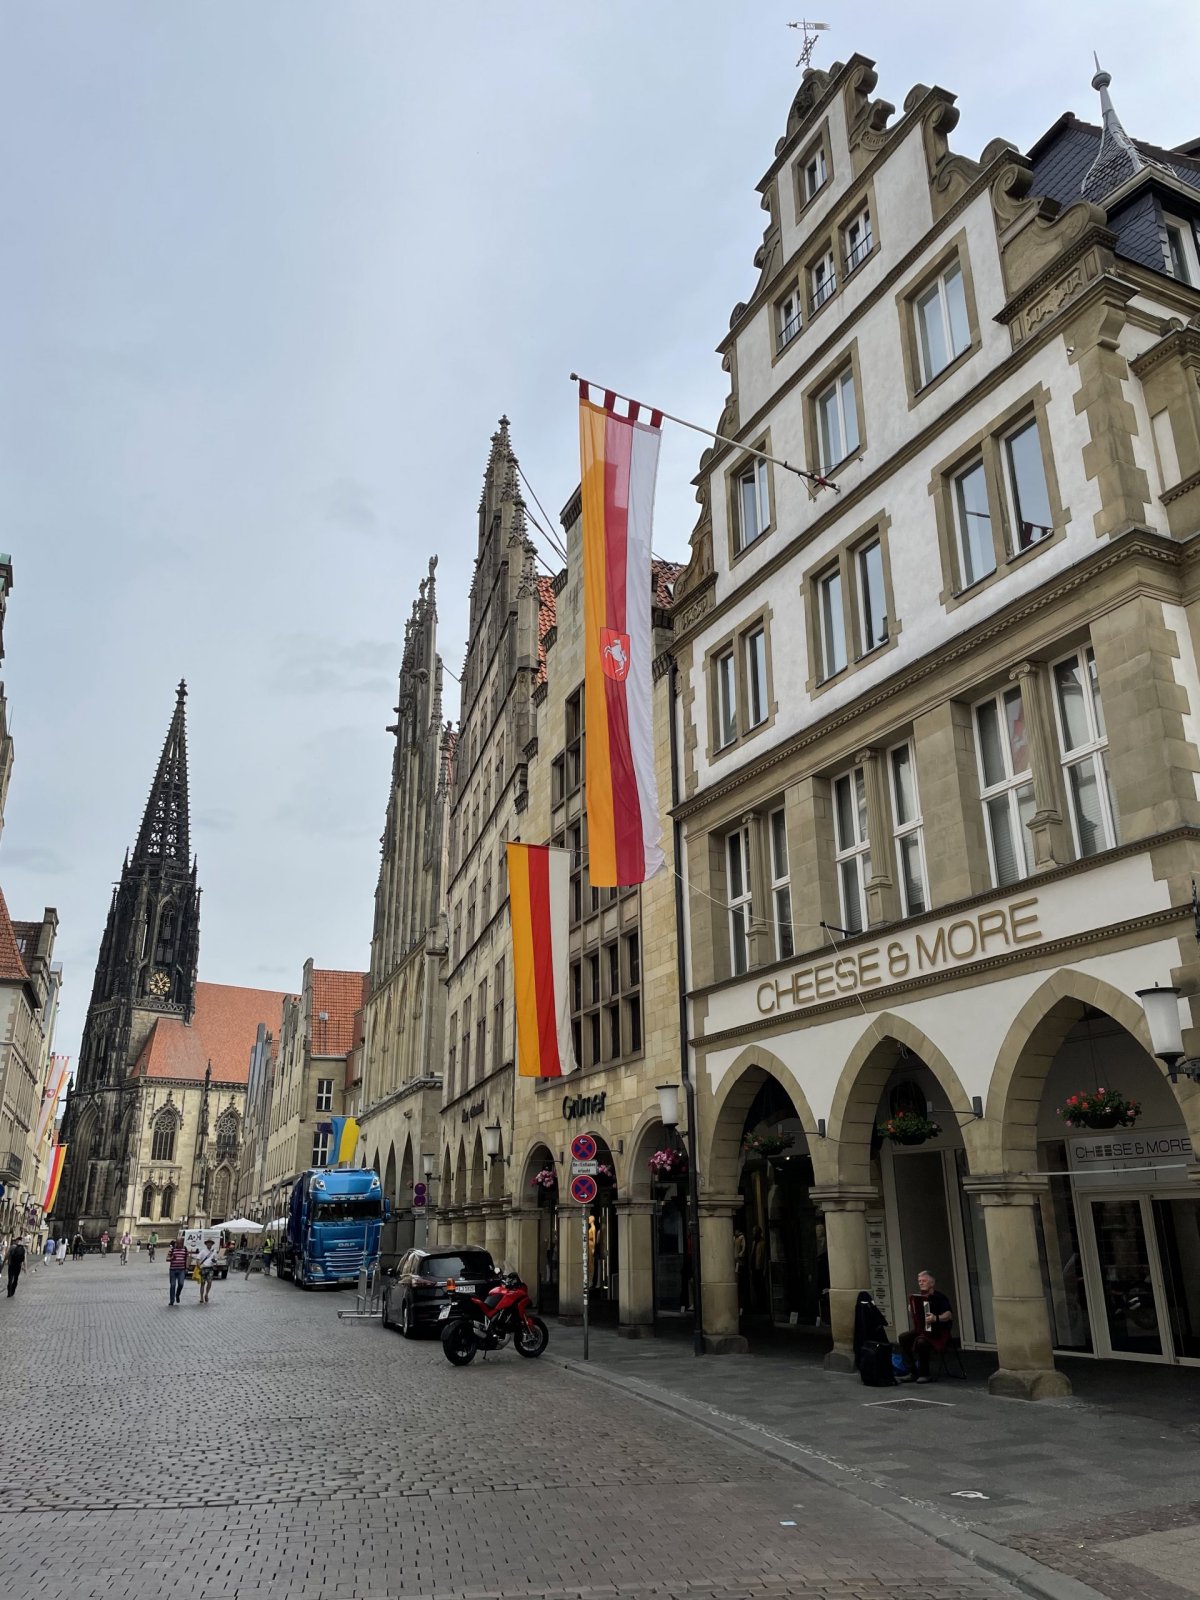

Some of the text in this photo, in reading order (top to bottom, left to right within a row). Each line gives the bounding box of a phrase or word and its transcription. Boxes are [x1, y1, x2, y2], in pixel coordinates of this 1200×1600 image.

[757, 896, 1043, 1014] CHEESE & MORE
[1075, 1138, 1193, 1159] CHEESE & MORE
